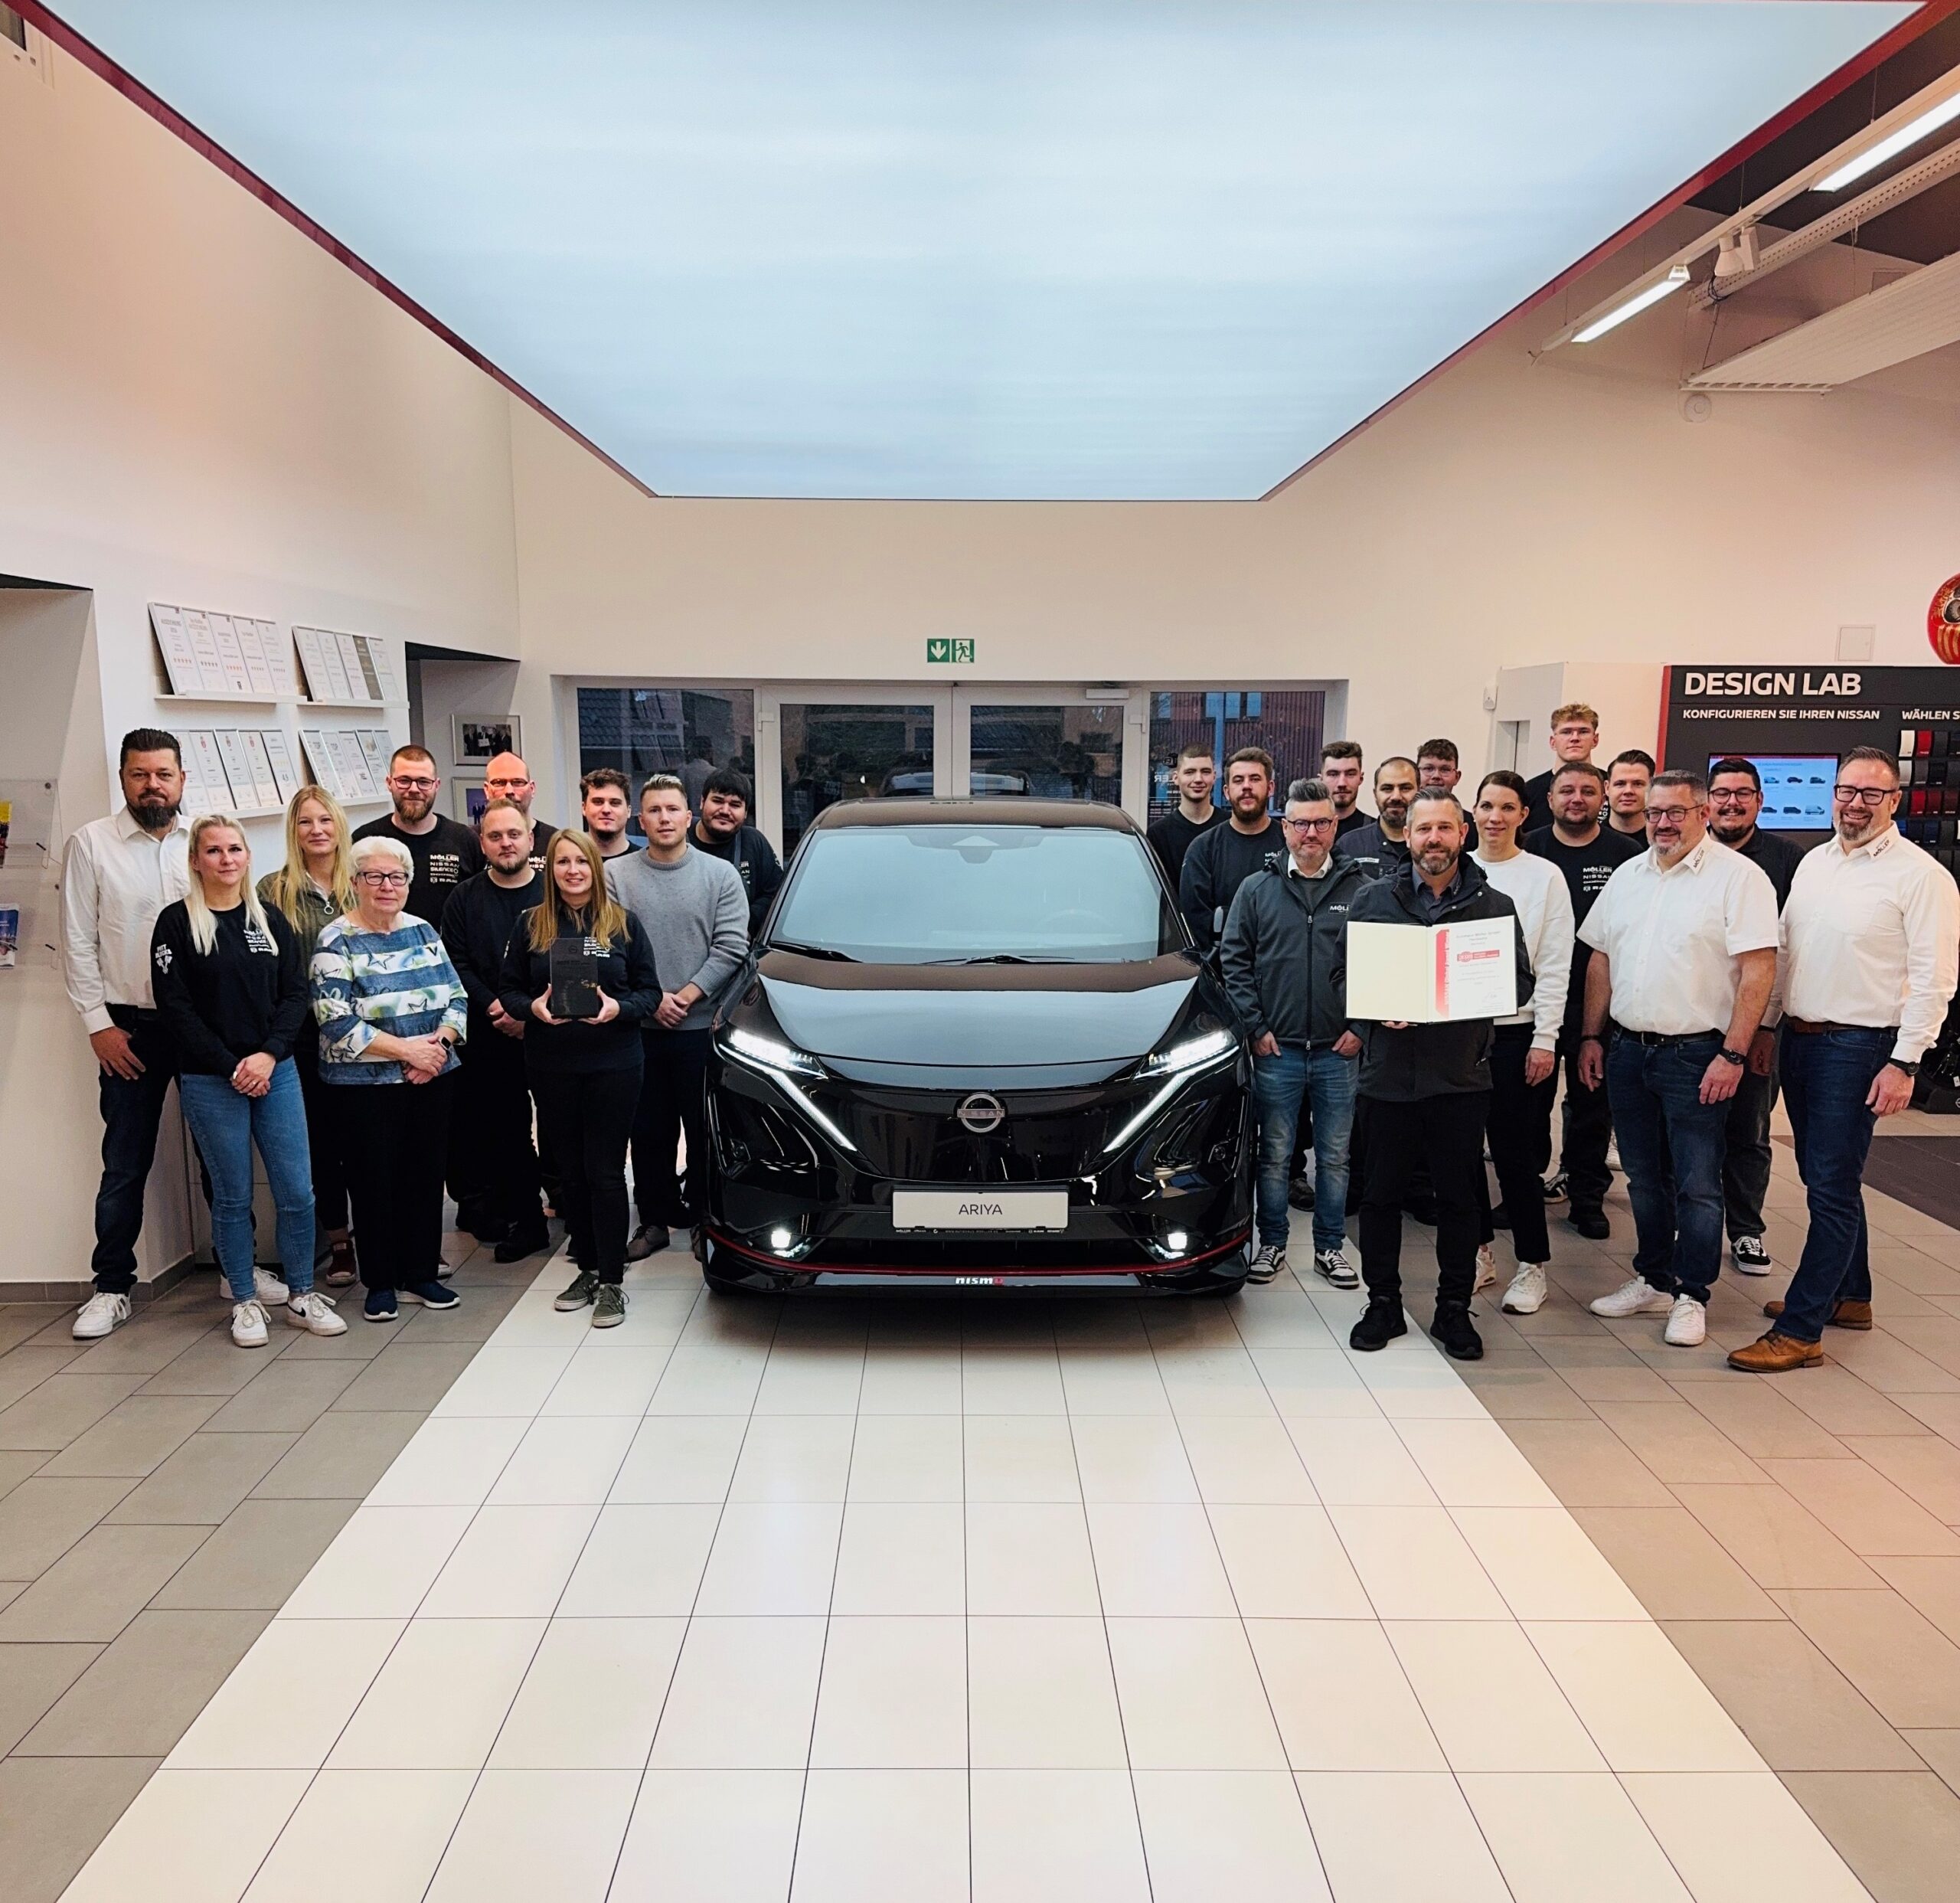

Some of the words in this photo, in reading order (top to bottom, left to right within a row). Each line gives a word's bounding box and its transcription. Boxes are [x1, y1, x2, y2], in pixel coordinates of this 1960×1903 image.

[1684, 672, 1795, 695] DESIGN
[1802, 673, 1861, 695] LAB
[1683, 709, 1776, 720] KONFIGURIEREN
[1779, 709, 1797, 720] SIE
[1799, 710, 1834, 720] IHREN
[1837, 710, 1880, 720] NISSAN
[1902, 708, 1950, 721] WÄHLEN
[959, 1204, 1003, 1215] ARIYA
[956, 1276, 1004, 1286] nismo
